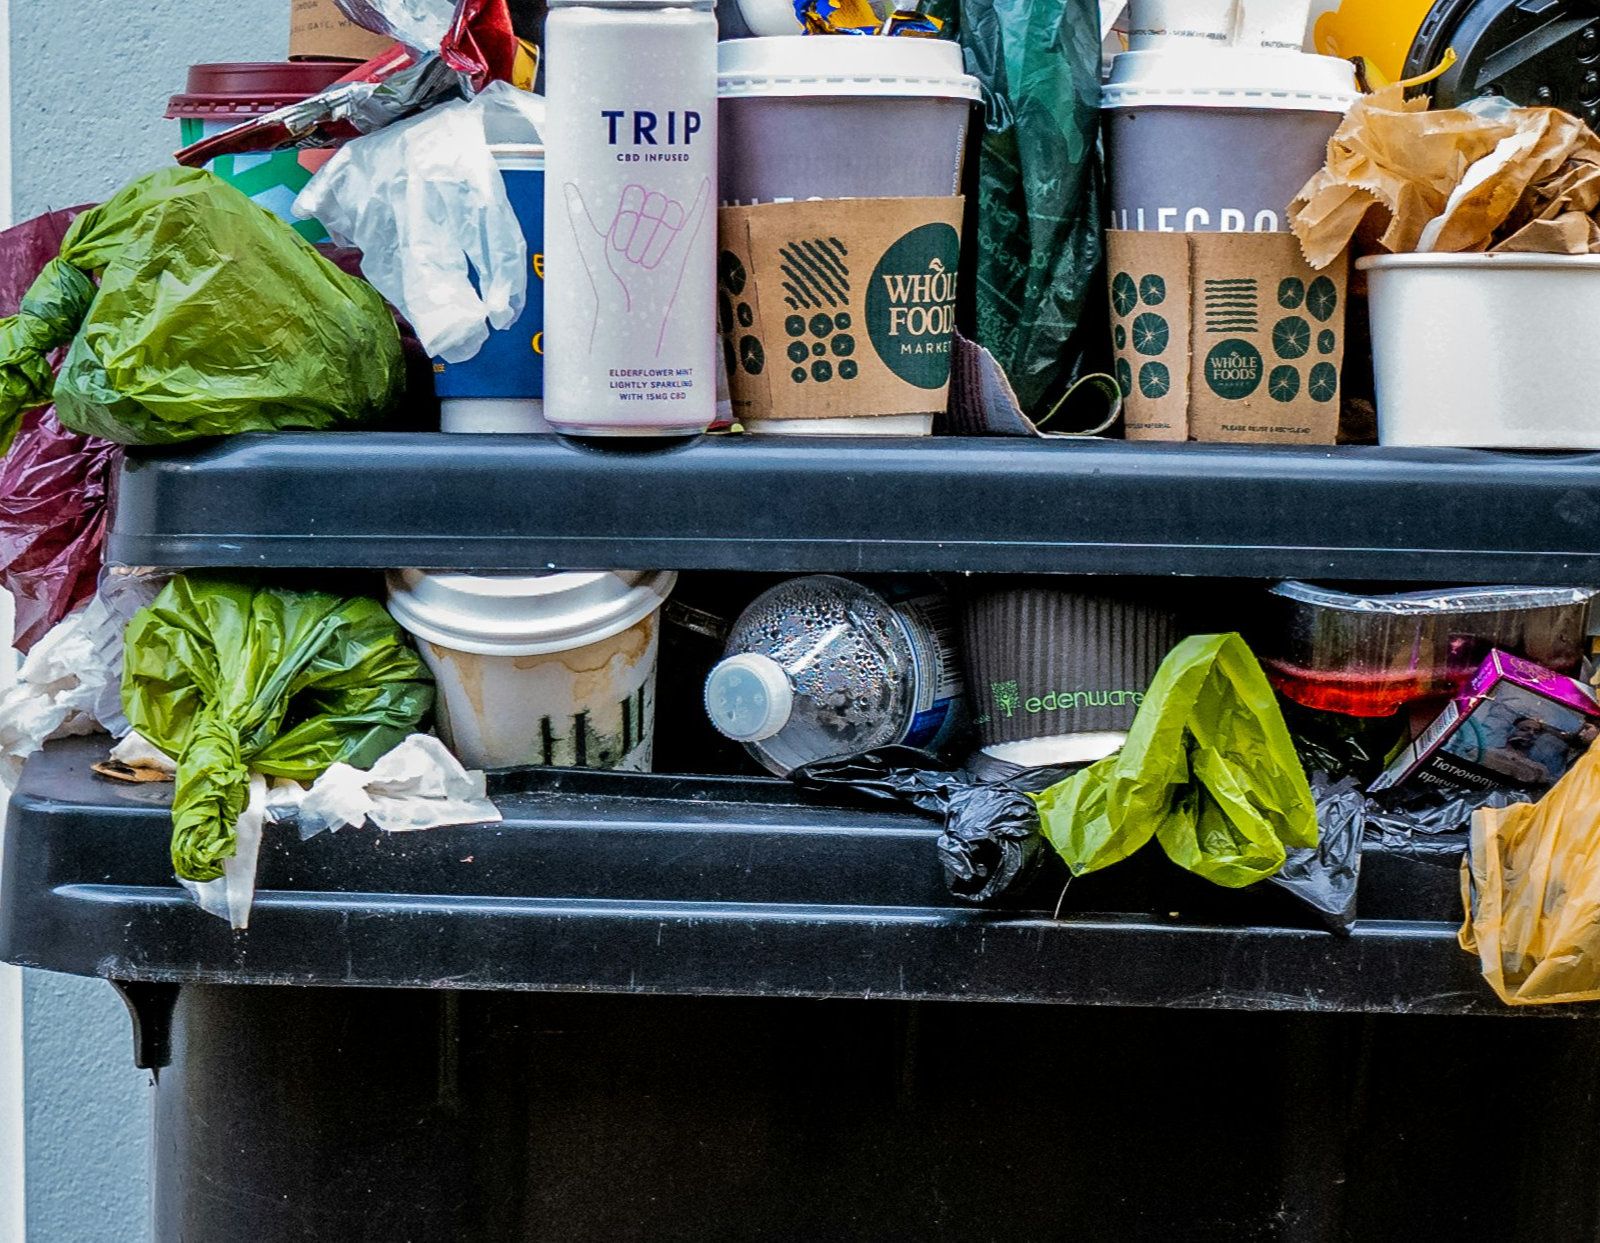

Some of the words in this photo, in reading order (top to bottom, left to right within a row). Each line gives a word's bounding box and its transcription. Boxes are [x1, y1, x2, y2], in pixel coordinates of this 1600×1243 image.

[601, 110, 701, 145] TRIP
[616, 153, 641, 162] CBD
[644, 153, 690, 162] INFUSED
[1210, 353, 1258, 369] WHOLE
[609, 368, 674, 377] ELDERFLOWER
[676, 368, 693, 376] MINT
[1213, 368, 1257, 380] FOODS
[609, 381, 648, 389] LIGHTLY
[650, 380, 693, 388] SPARKLING
[646, 392, 668, 400] 15MG
[670, 391, 687, 399] CBD
[1025, 690, 1145, 713] edenware
